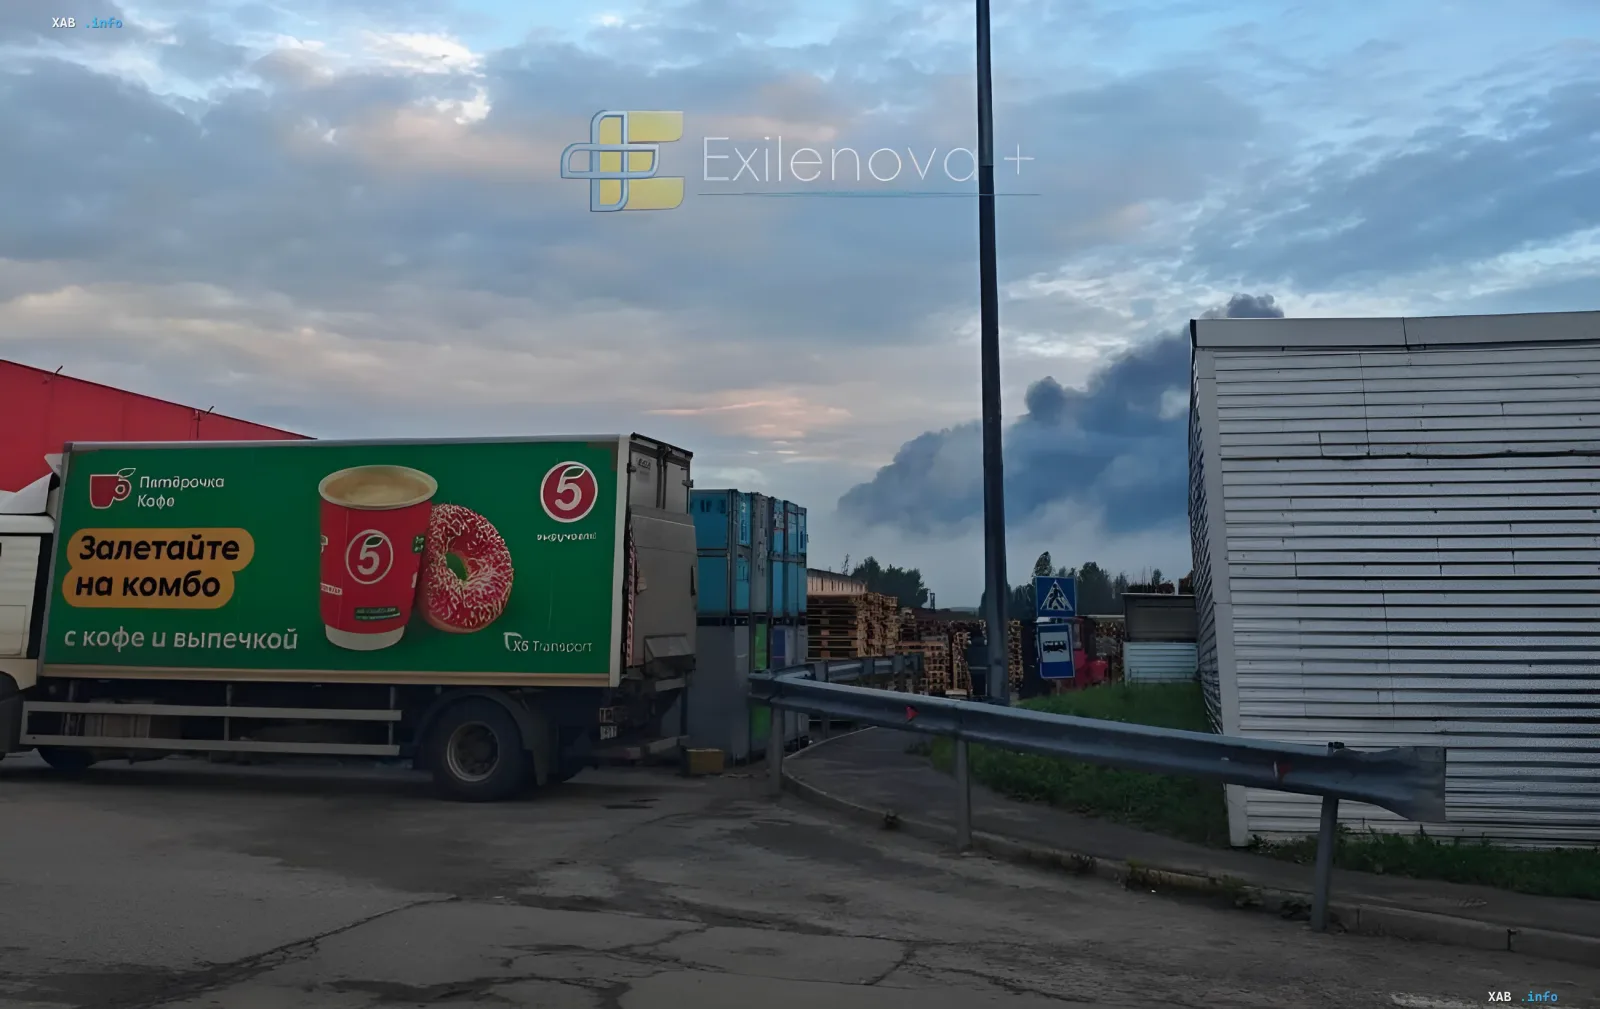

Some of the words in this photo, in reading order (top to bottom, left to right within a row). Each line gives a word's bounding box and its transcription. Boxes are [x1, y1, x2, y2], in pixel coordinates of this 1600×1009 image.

[554, 465, 586, 511] 5
[79, 533, 240, 560] Залетайте
[75, 576, 113, 596] на
[122, 569, 221, 597] комбо
[64, 630, 76, 647] с
[82, 626, 145, 652] кофе
[152, 631, 166, 647] и
[173, 627, 298, 650] выпечкой
